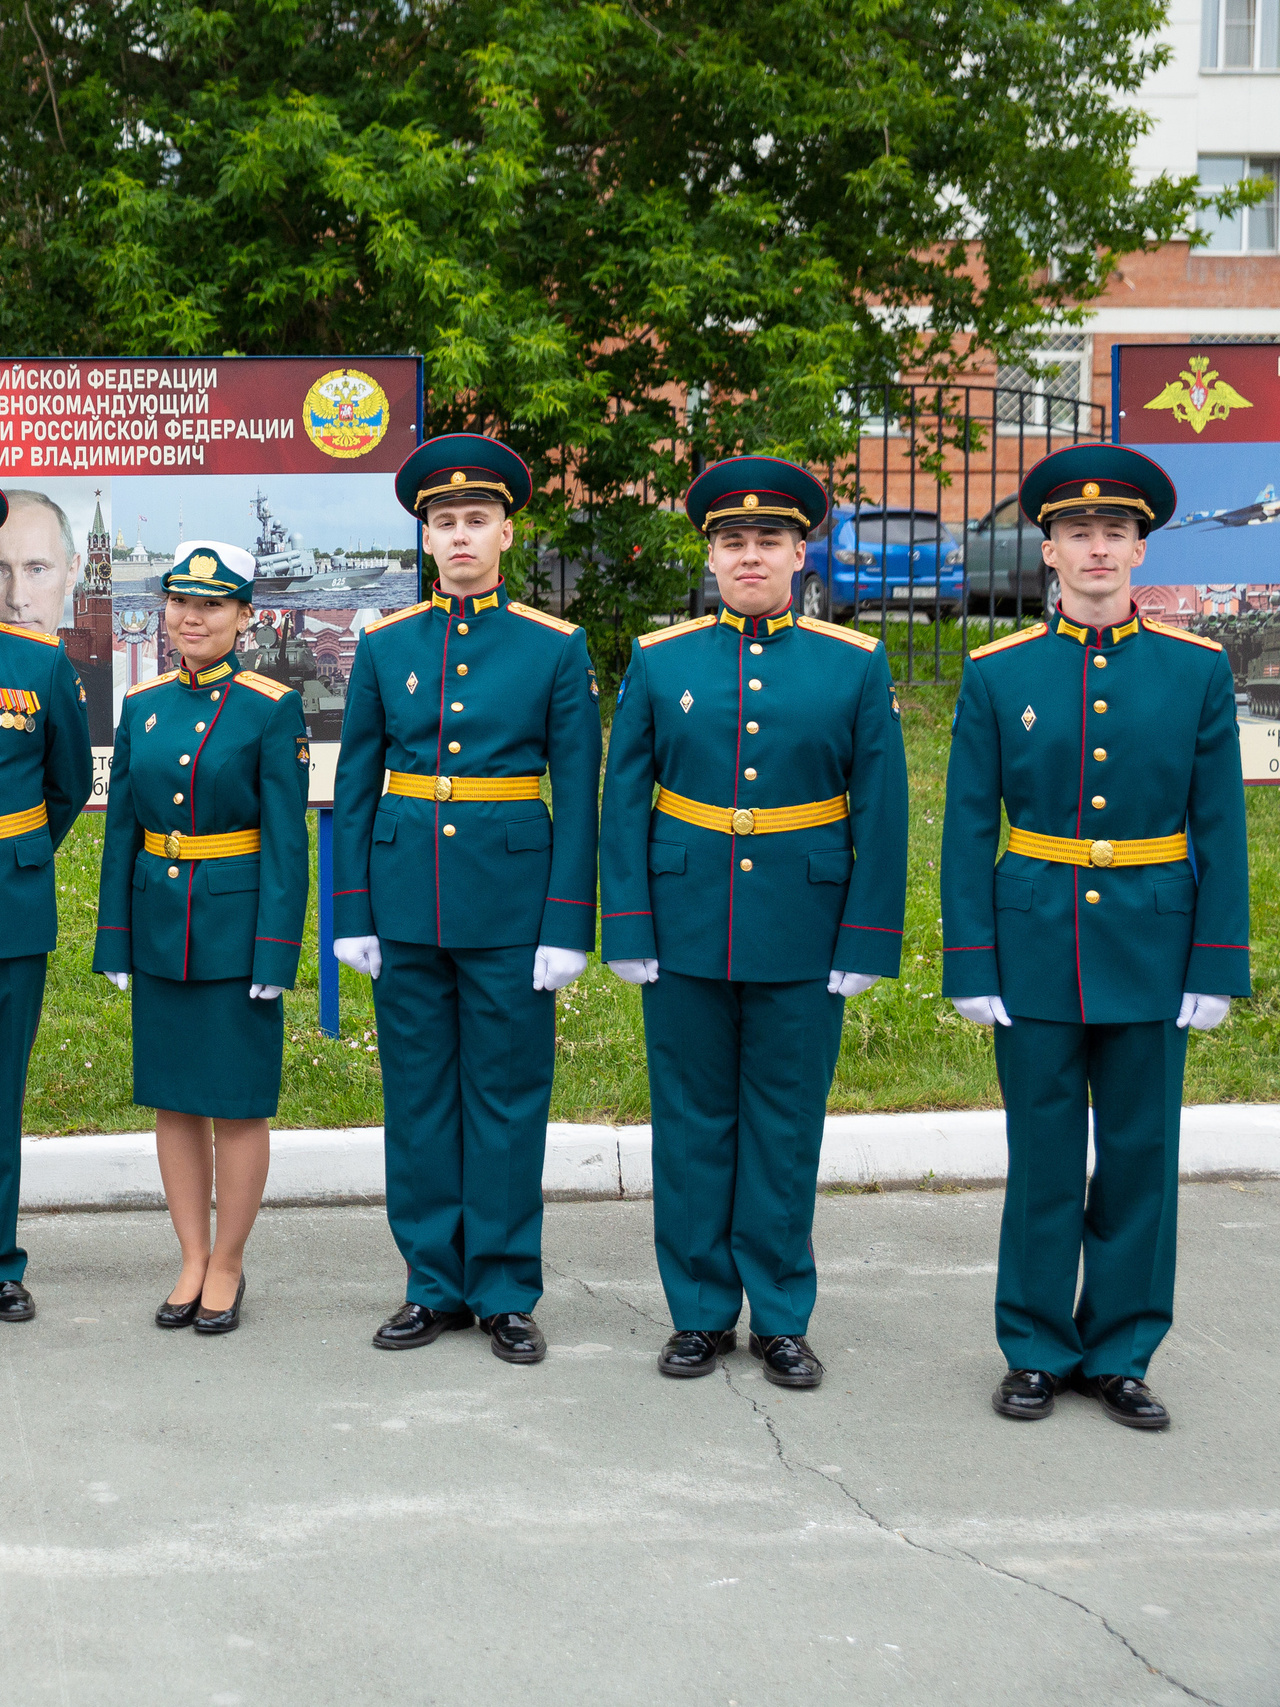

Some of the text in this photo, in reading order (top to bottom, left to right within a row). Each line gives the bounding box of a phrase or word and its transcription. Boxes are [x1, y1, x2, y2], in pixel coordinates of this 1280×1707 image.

[87, 368, 218, 393] ФЕДЕРАЦИИ
[21, 415, 159, 441] РОССИЙСКОЙ
[164, 418, 295, 443] ФЕДЕРАЦИИ
[30, 444, 205, 470] ВЛАДИМИРОВИЧ
[331, 577, 347, 587] 825
